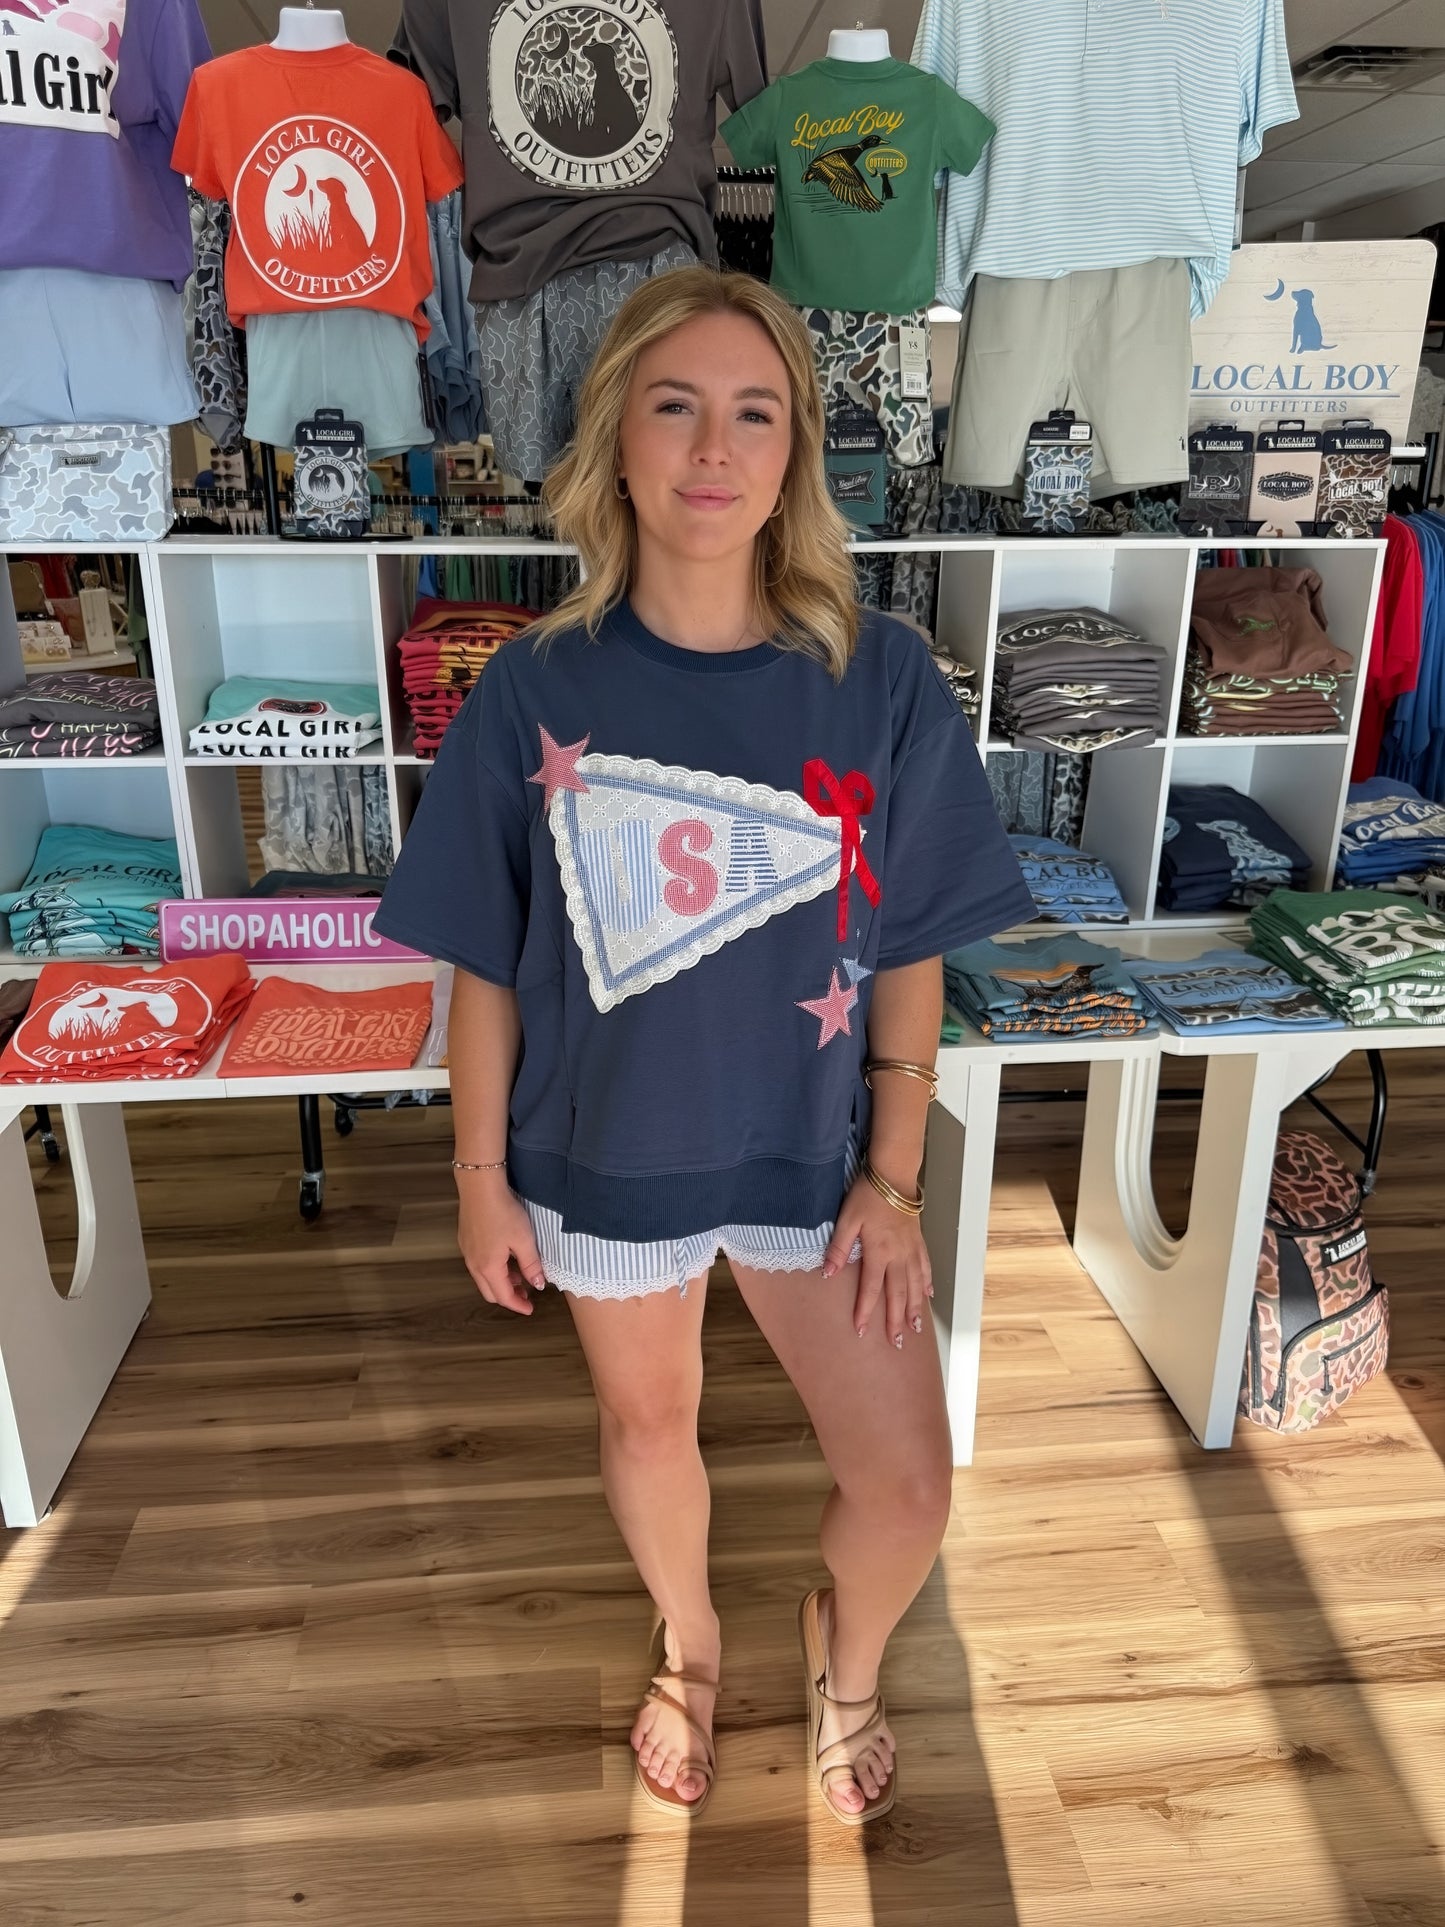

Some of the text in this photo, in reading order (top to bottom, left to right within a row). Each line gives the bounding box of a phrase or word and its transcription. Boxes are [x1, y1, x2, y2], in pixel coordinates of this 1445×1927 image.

[603, 0, 655, 27] OY
[791, 104, 905, 150] Local Boy
[255, 125, 376, 179] LOCAL GIRL
[514, 128, 663, 184] OUTFITTERS
[869, 157, 904, 168] OUTFITTERS
[264, 253, 388, 295] OUTFITTERS
[1190, 364, 1400, 391] LOCAL BOY
[1230, 400, 1348, 413] OUTFITTERS
[861, 436, 876, 444] BOY
[1277, 436, 1316, 445] LOCAL BOY
[307, 458, 329, 471] LOCAL
[1034, 475, 1082, 490] LOCAL BOY
[1330, 483, 1360, 499] LOCAL
[307, 493, 349, 508] OUTFITTERS
[1009, 621, 1092, 643] LOCAL
[198, 720, 290, 738] LOCAL
[1355, 813, 1410, 841] ocal
[25, 863, 117, 887] LOCAL
[578, 818, 779, 933] USA
[1020, 866, 1069, 881] CAL
[180, 912, 382, 951] SHOPAHOLIC
